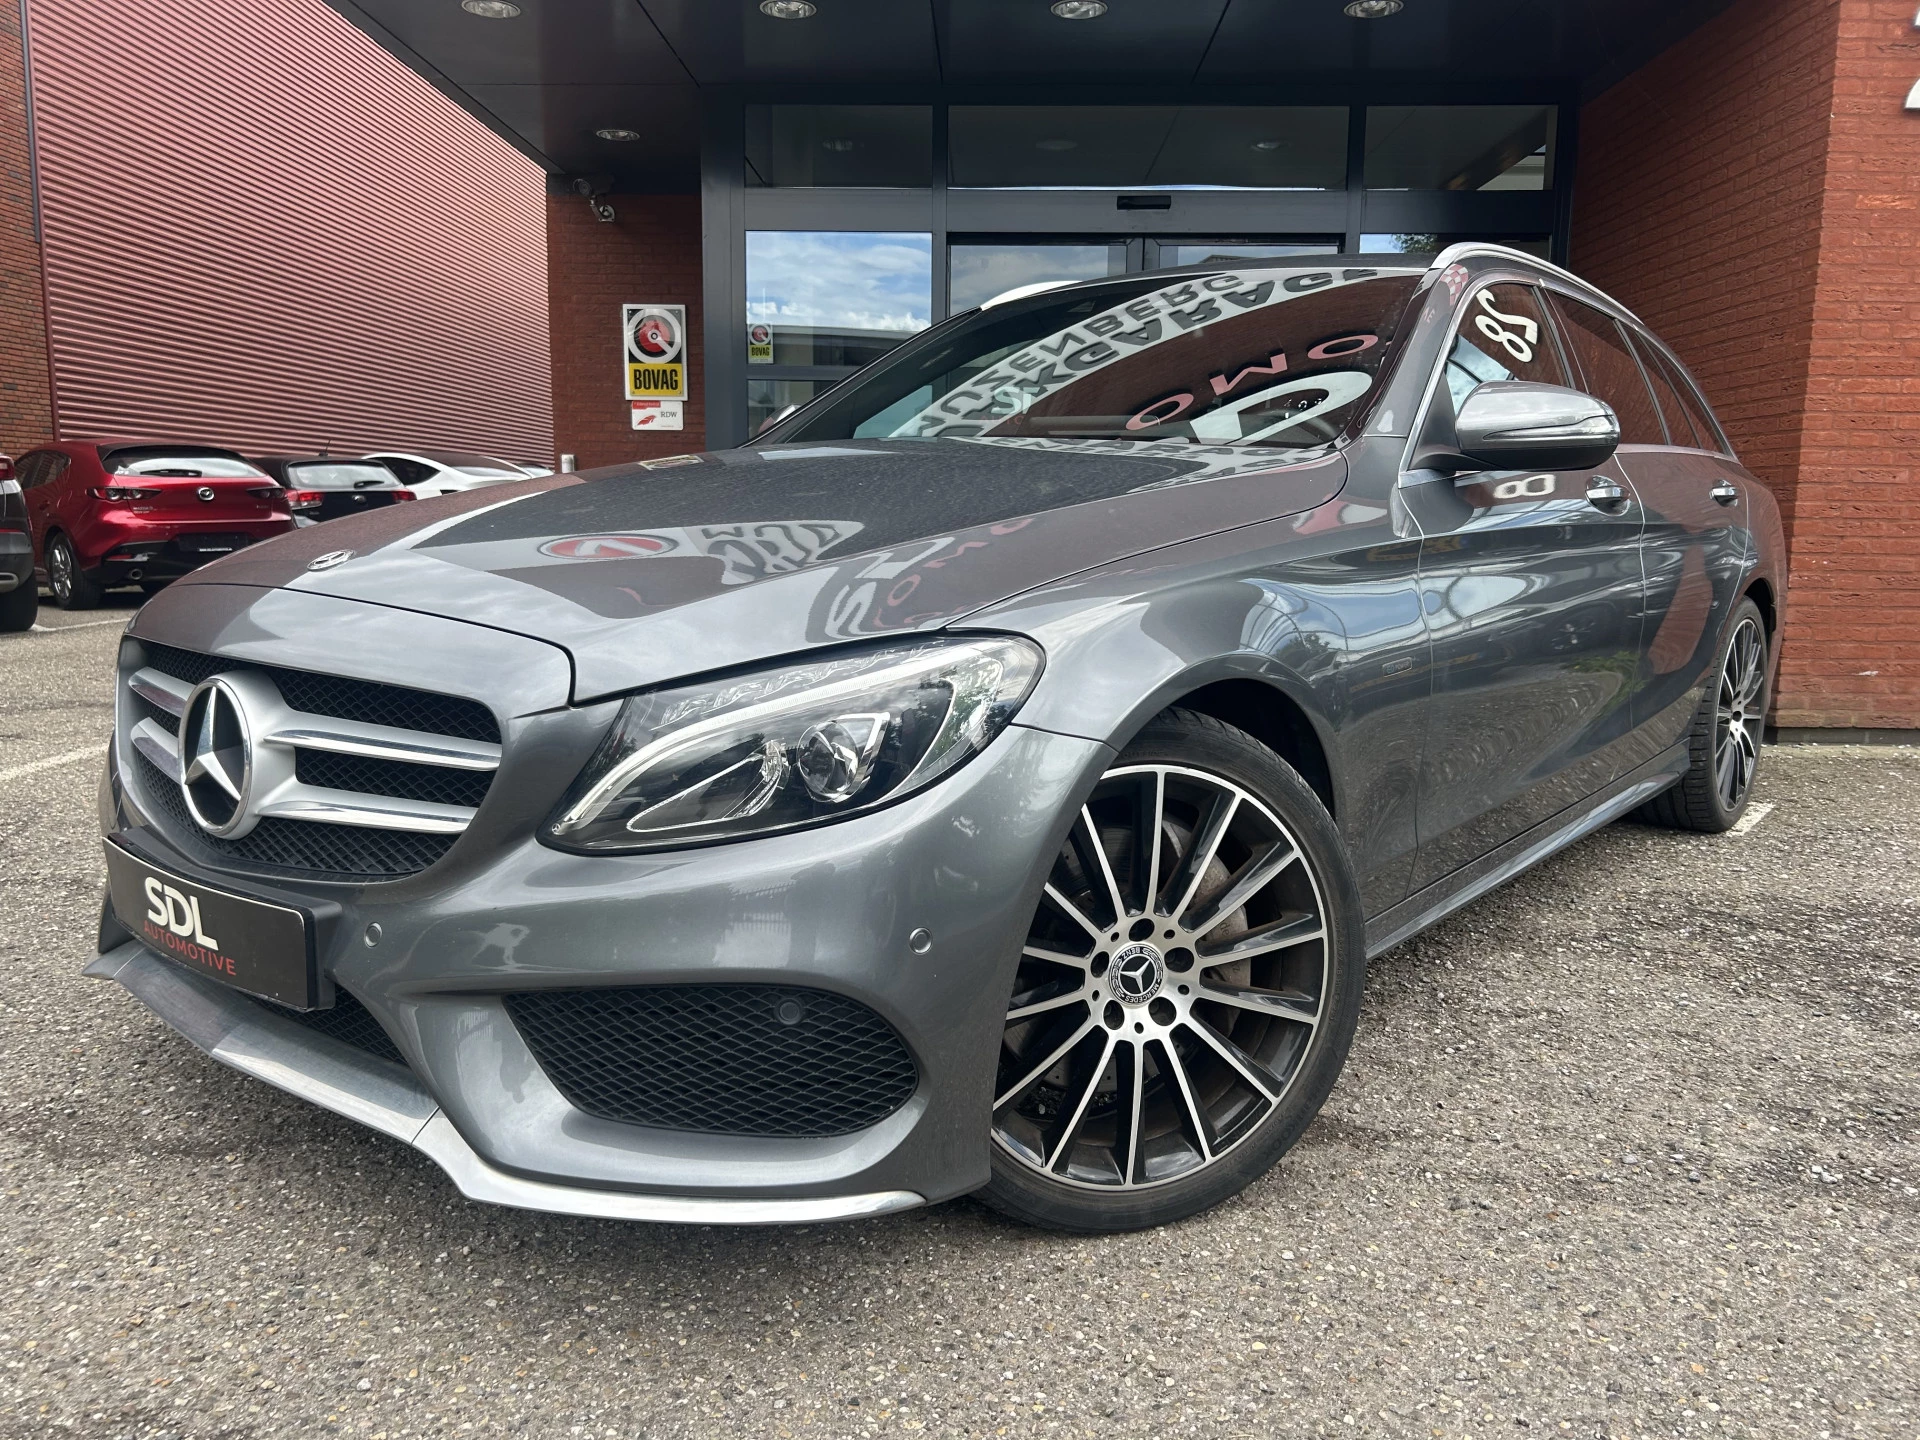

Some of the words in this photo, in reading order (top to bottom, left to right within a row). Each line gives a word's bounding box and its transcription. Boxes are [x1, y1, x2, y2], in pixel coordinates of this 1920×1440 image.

[750, 346, 770, 357] BOVAG
[634, 368, 679, 391] BOVAG
[144, 877, 218, 950] SDL
[144, 921, 237, 976] AUTOMOTIVE
[1121, 947, 1140, 960] BENZ
[1124, 982, 1161, 1004] MERCEDES
